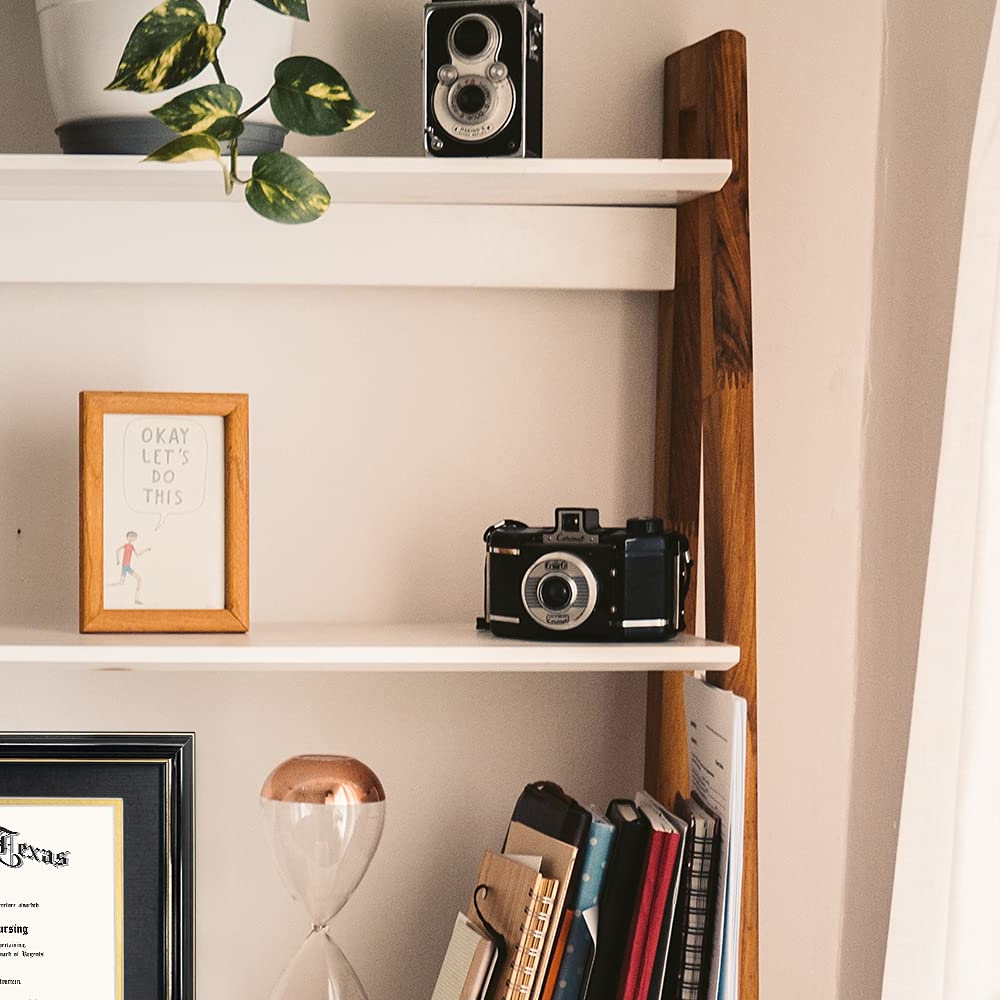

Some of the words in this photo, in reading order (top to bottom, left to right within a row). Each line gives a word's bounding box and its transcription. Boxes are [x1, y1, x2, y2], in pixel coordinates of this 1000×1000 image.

[142, 427, 190, 445] OKAY
[142, 449, 189, 465] LET'S
[152, 470, 175, 484] DO
[143, 488, 183, 505] THIS
